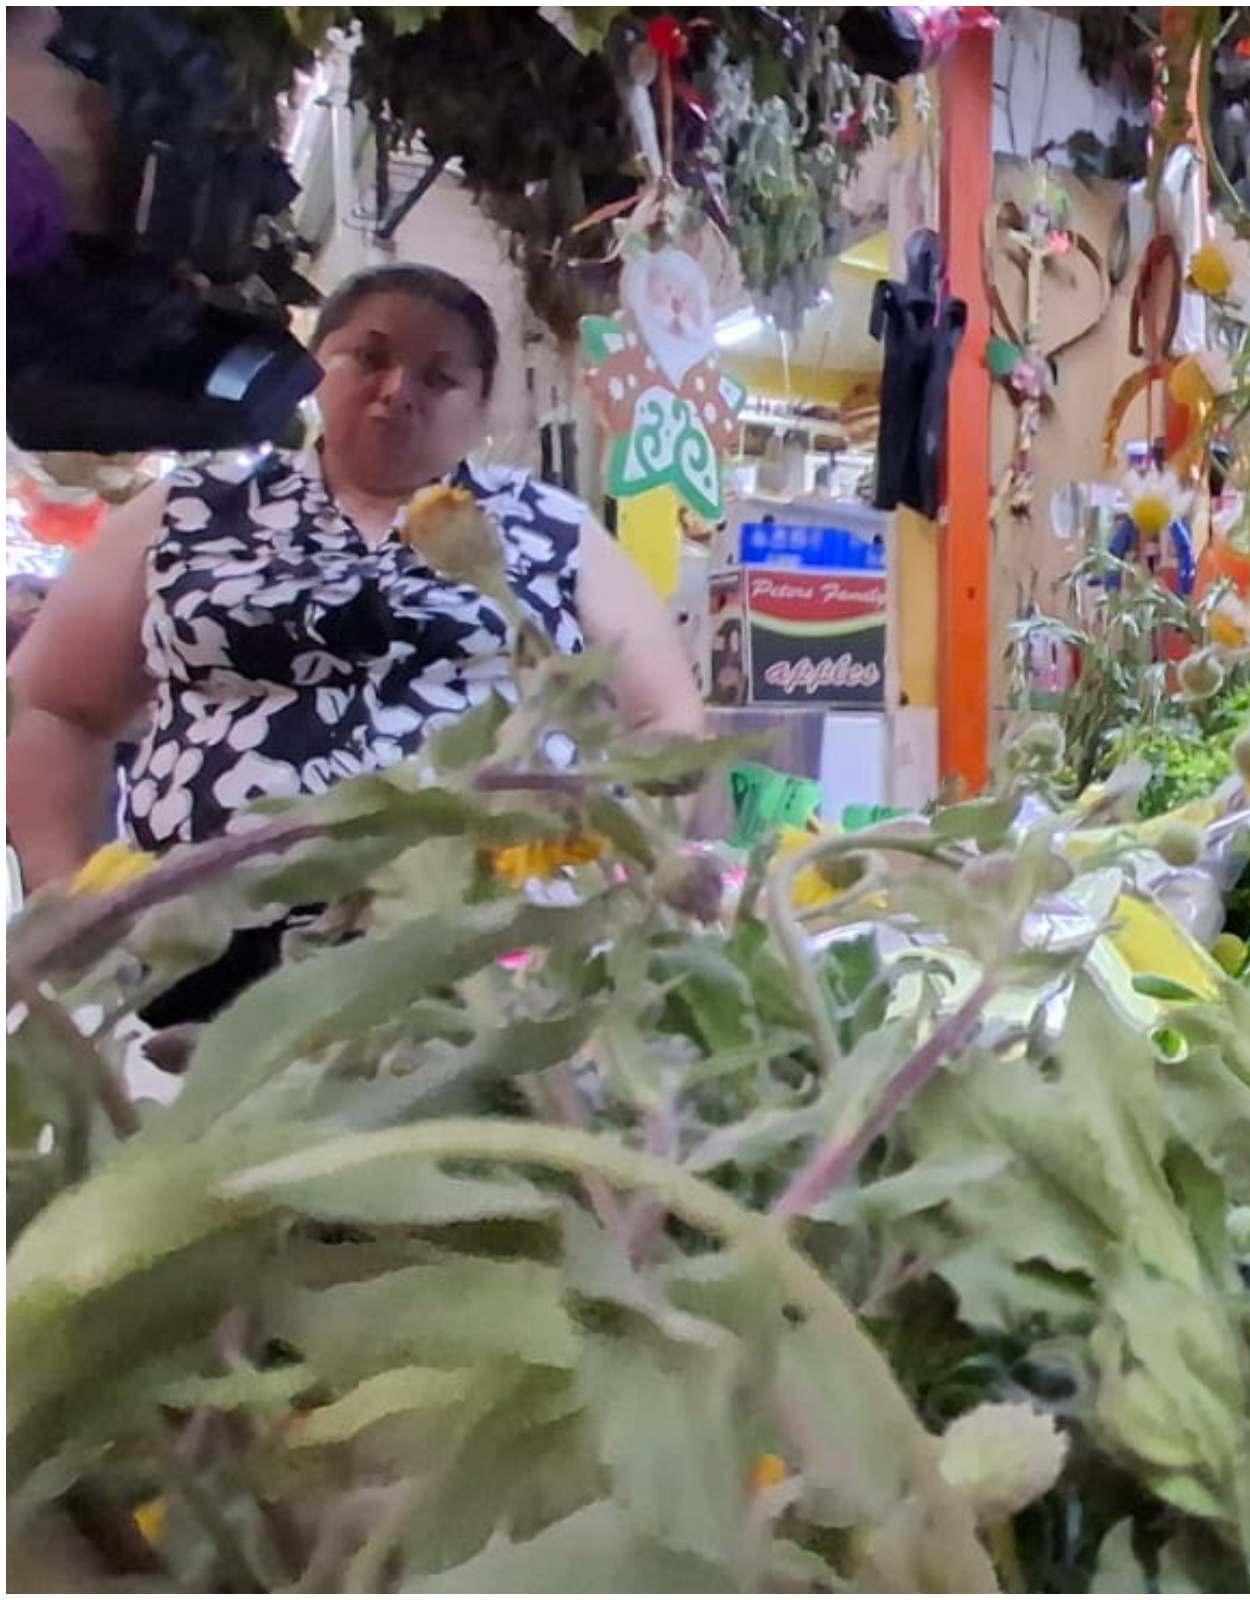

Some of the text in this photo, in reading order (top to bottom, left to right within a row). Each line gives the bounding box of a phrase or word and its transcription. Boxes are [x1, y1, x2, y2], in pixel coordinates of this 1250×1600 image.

[751, 577, 887, 607] Peters Family
[764, 652, 881, 694] apples
